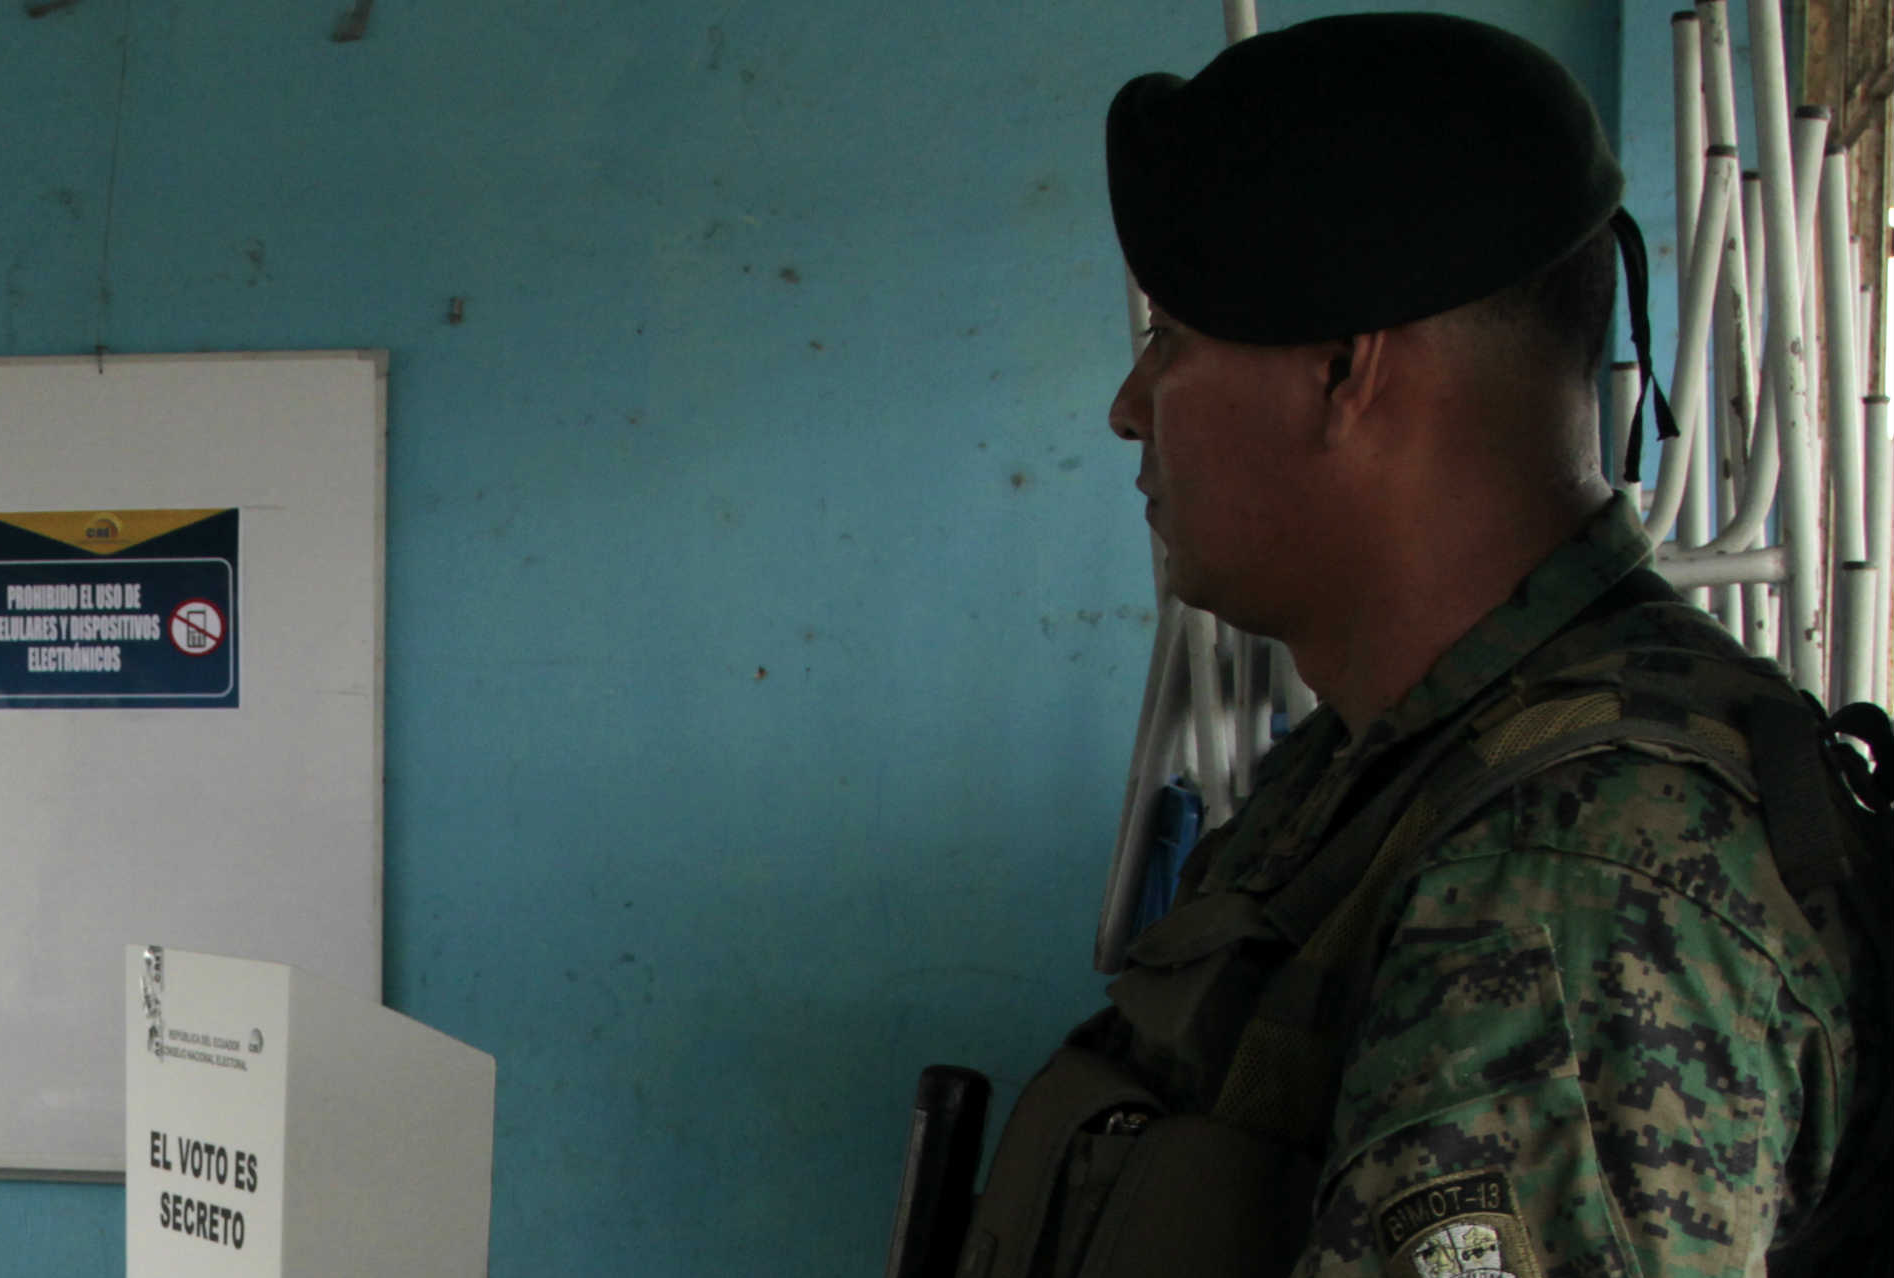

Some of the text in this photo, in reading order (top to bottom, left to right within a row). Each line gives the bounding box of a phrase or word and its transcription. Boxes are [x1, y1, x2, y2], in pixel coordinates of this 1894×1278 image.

[7, 583, 142, 610] PROHIBIDO EL USO DE
[59, 615, 69, 641] Y
[70, 614, 162, 641] DISPOSITIVOS
[27, 642, 122, 672] ELECTRÓNICOS
[150, 1130, 258, 1194] EL VOTO ES
[160, 1191, 245, 1250] SECRETO
